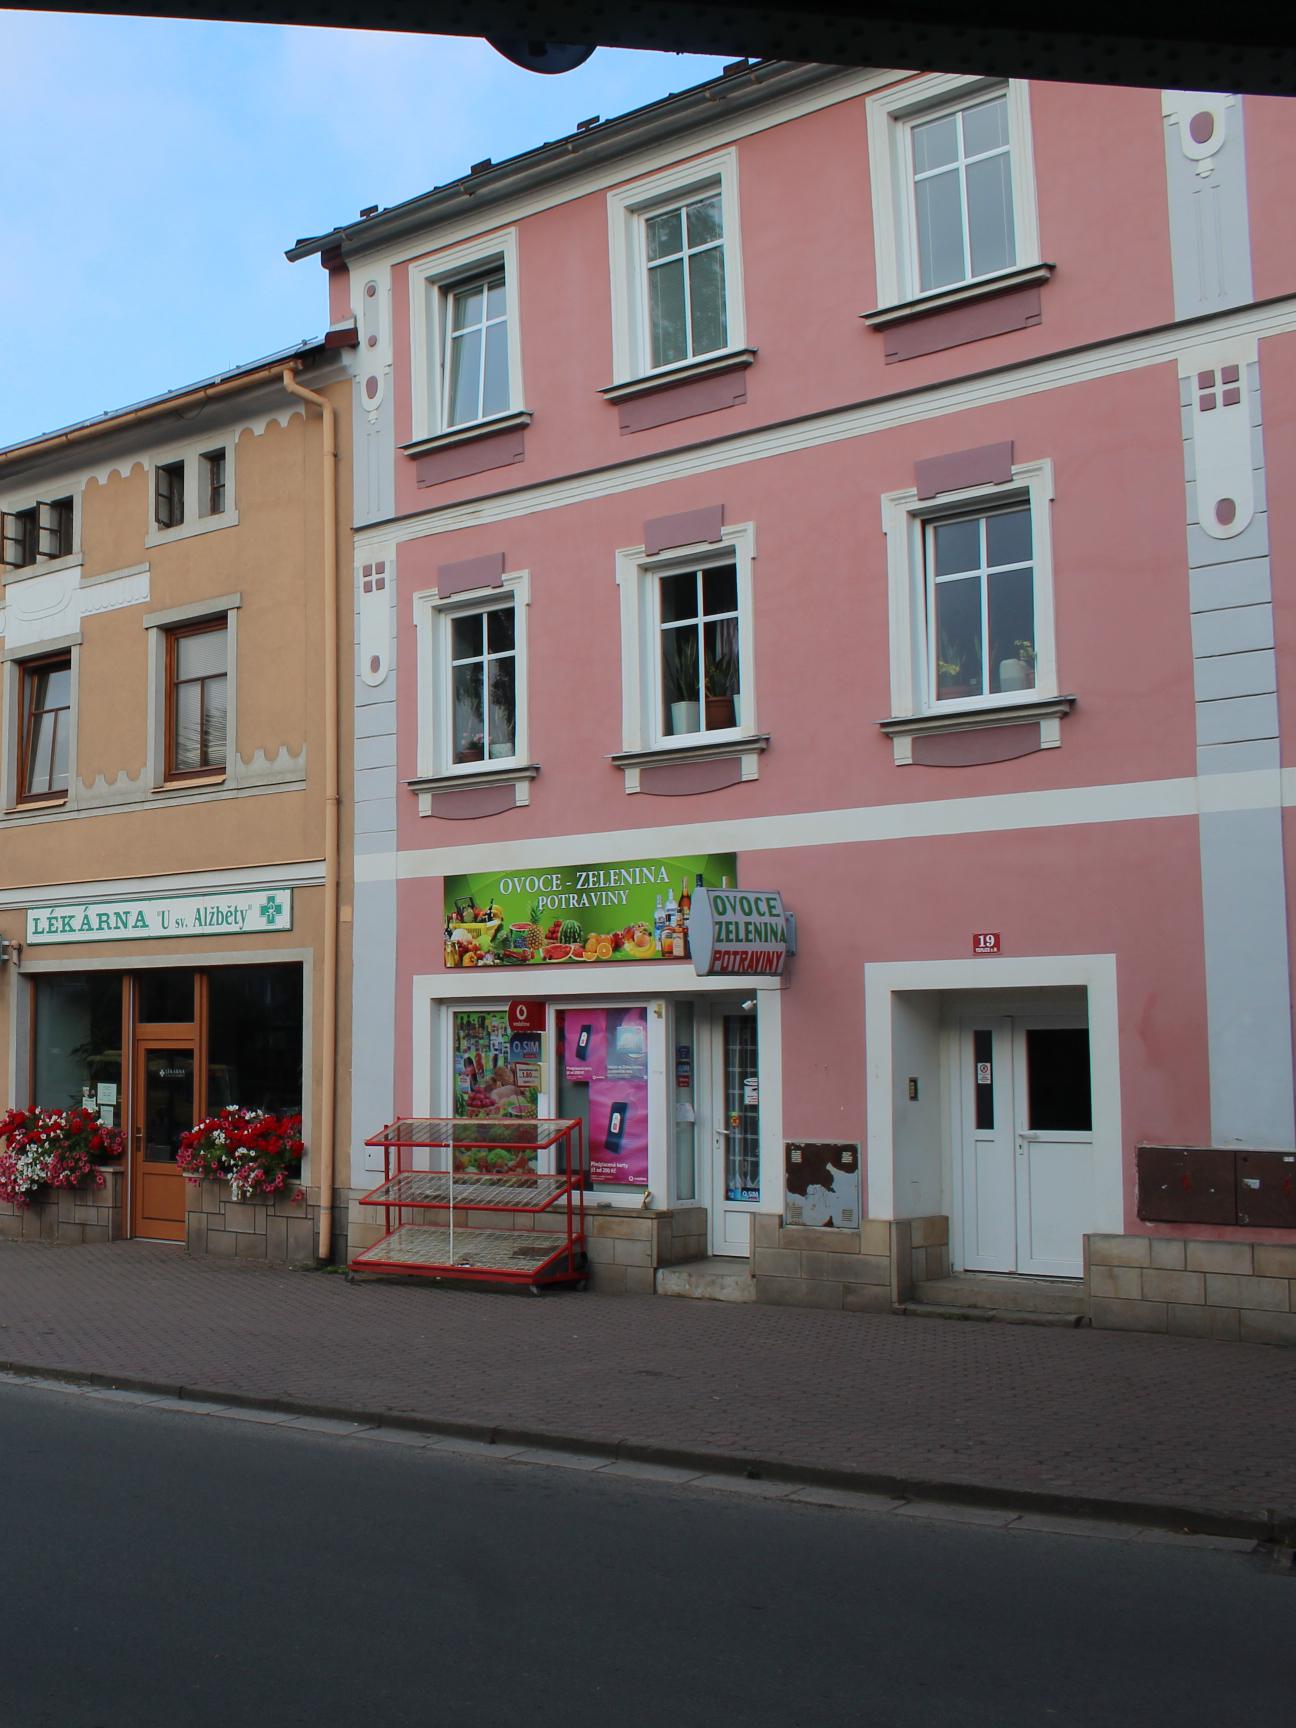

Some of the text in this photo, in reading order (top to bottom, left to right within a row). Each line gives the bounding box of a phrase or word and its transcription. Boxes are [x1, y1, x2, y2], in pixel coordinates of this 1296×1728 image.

[499, 874, 562, 895] OVOCE
[575, 865, 670, 889] ZELENINA
[538, 890, 629, 911] POTRAVINY
[712, 895, 781, 917] OVOCE
[32, 906, 150, 935] LÉKÁRNA
[174, 917, 188, 929] sv.
[714, 920, 787, 943] ZELENINA
[978, 934, 995, 947] 19
[710, 949, 783, 974] POTRAVINY
[522, 1041, 539, 1053] SIM
